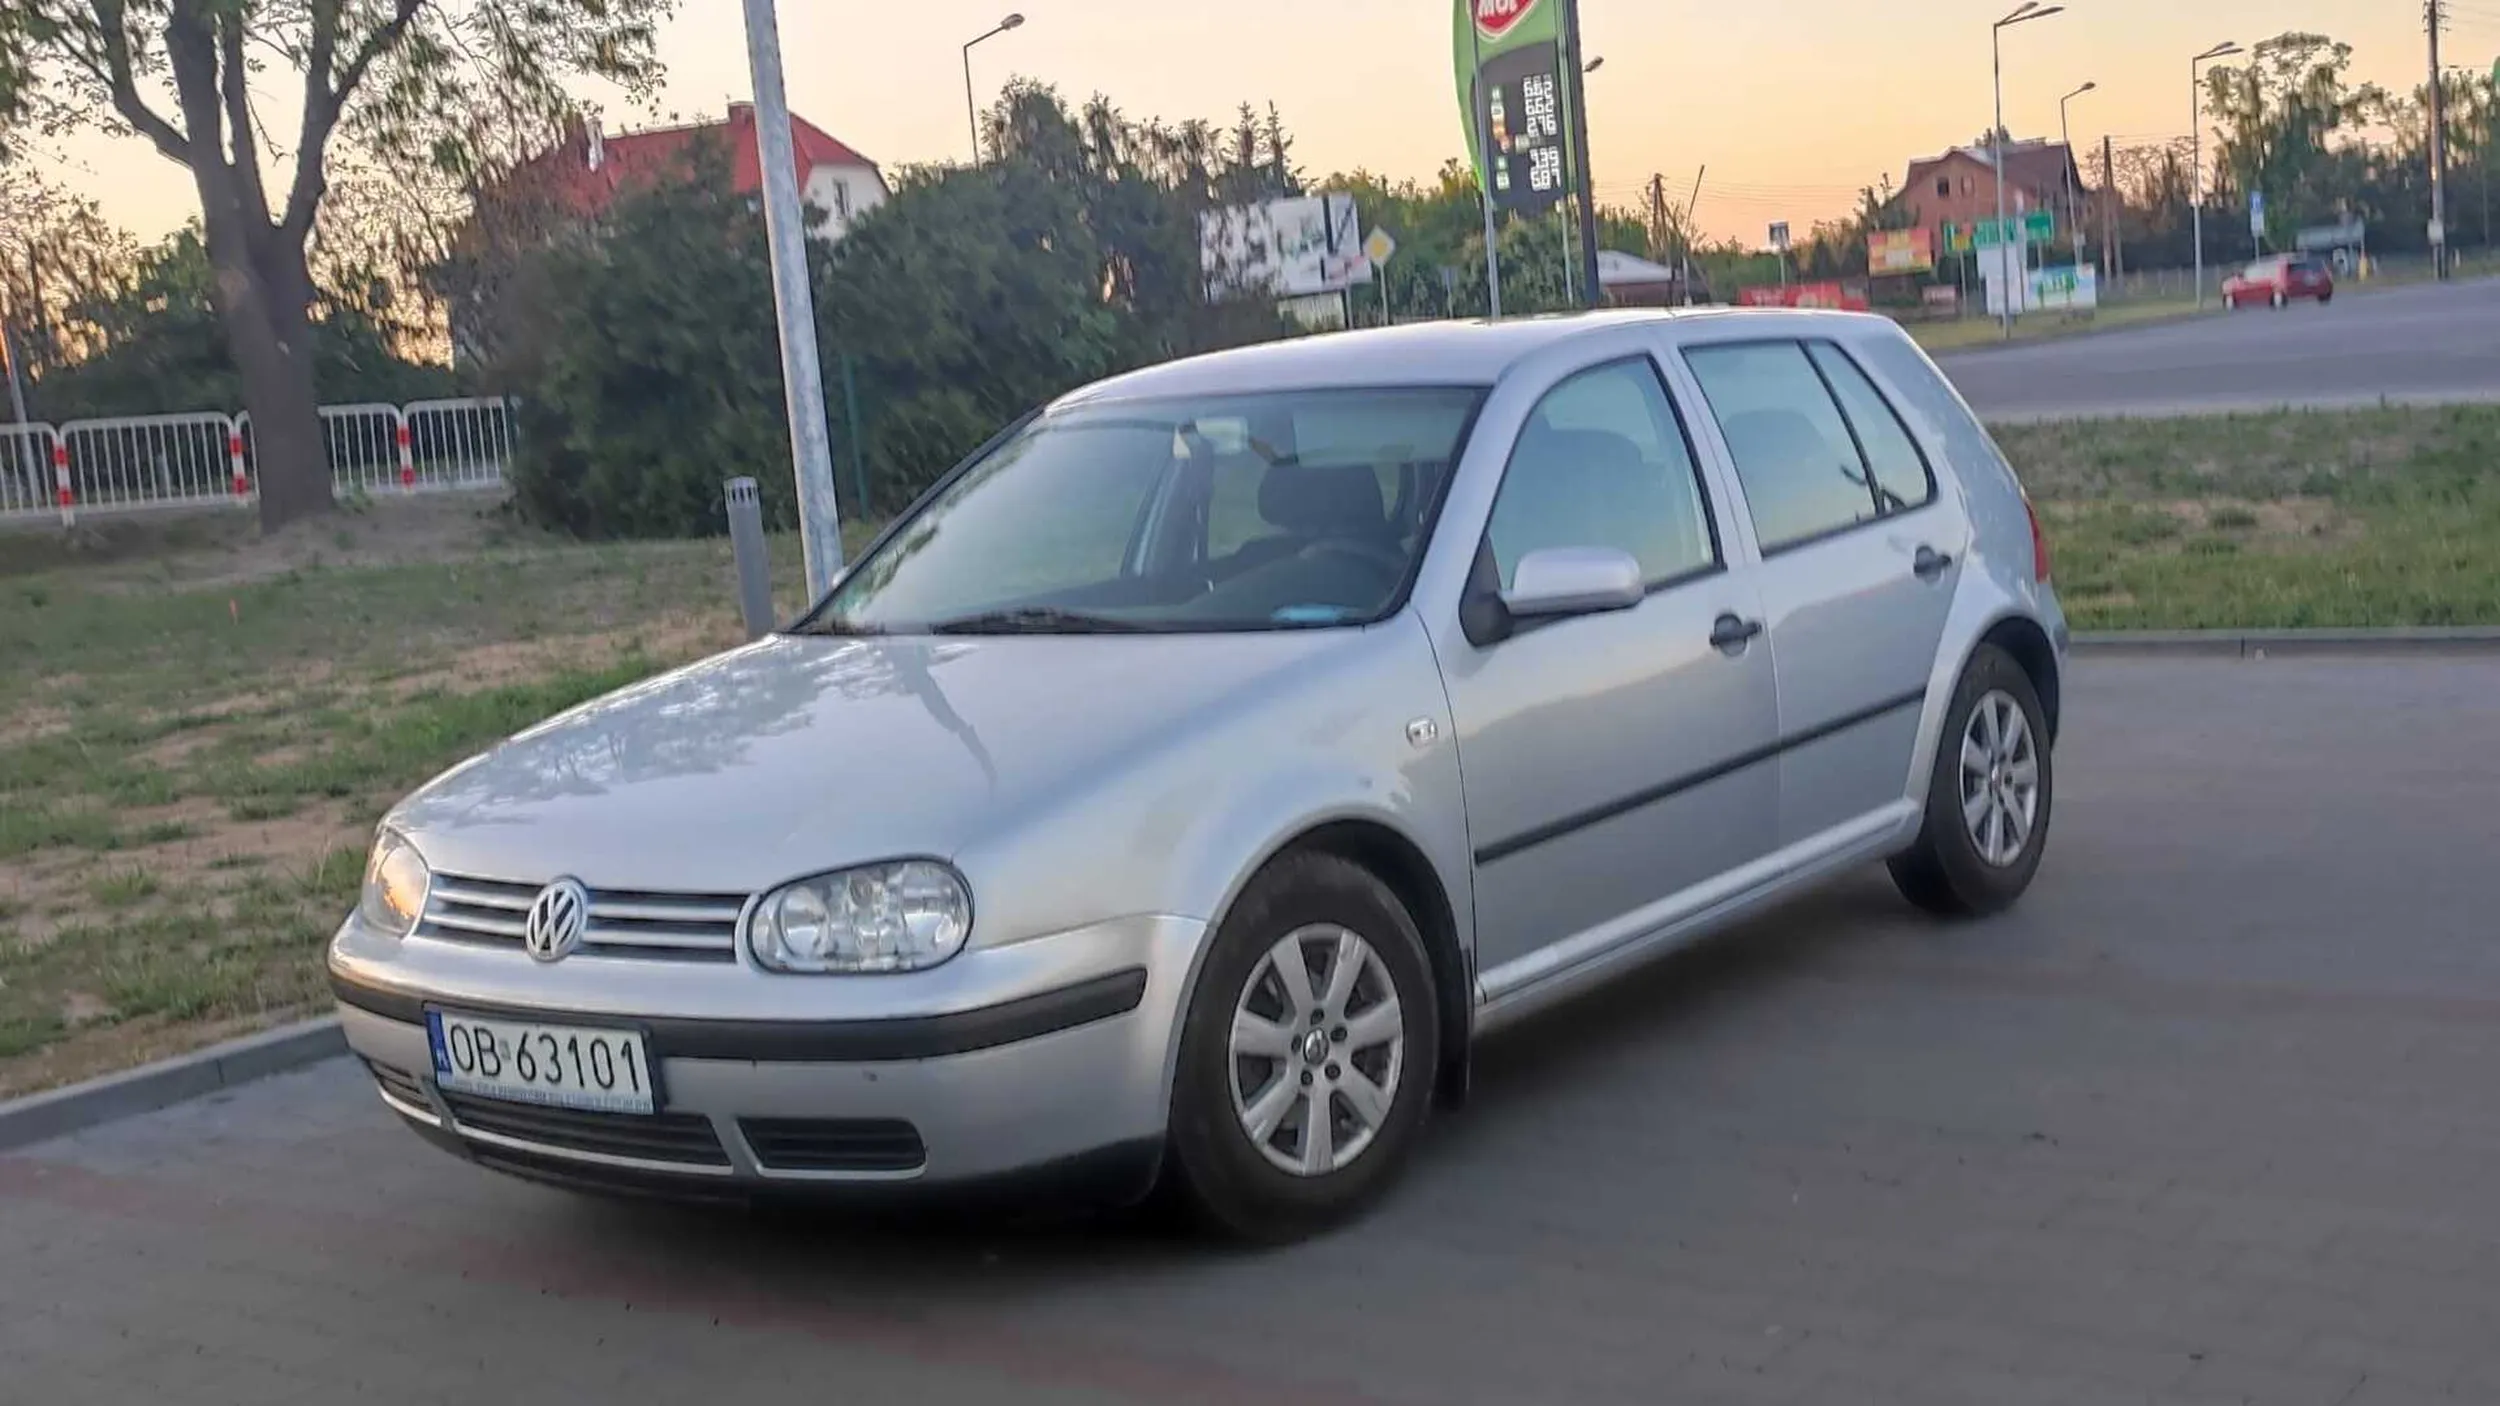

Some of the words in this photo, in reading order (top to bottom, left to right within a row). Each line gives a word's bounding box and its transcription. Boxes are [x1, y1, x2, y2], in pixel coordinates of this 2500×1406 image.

[527, 882, 586, 959] VW
[450, 1023, 502, 1077] OB
[516, 1030, 640, 1094] 63101
